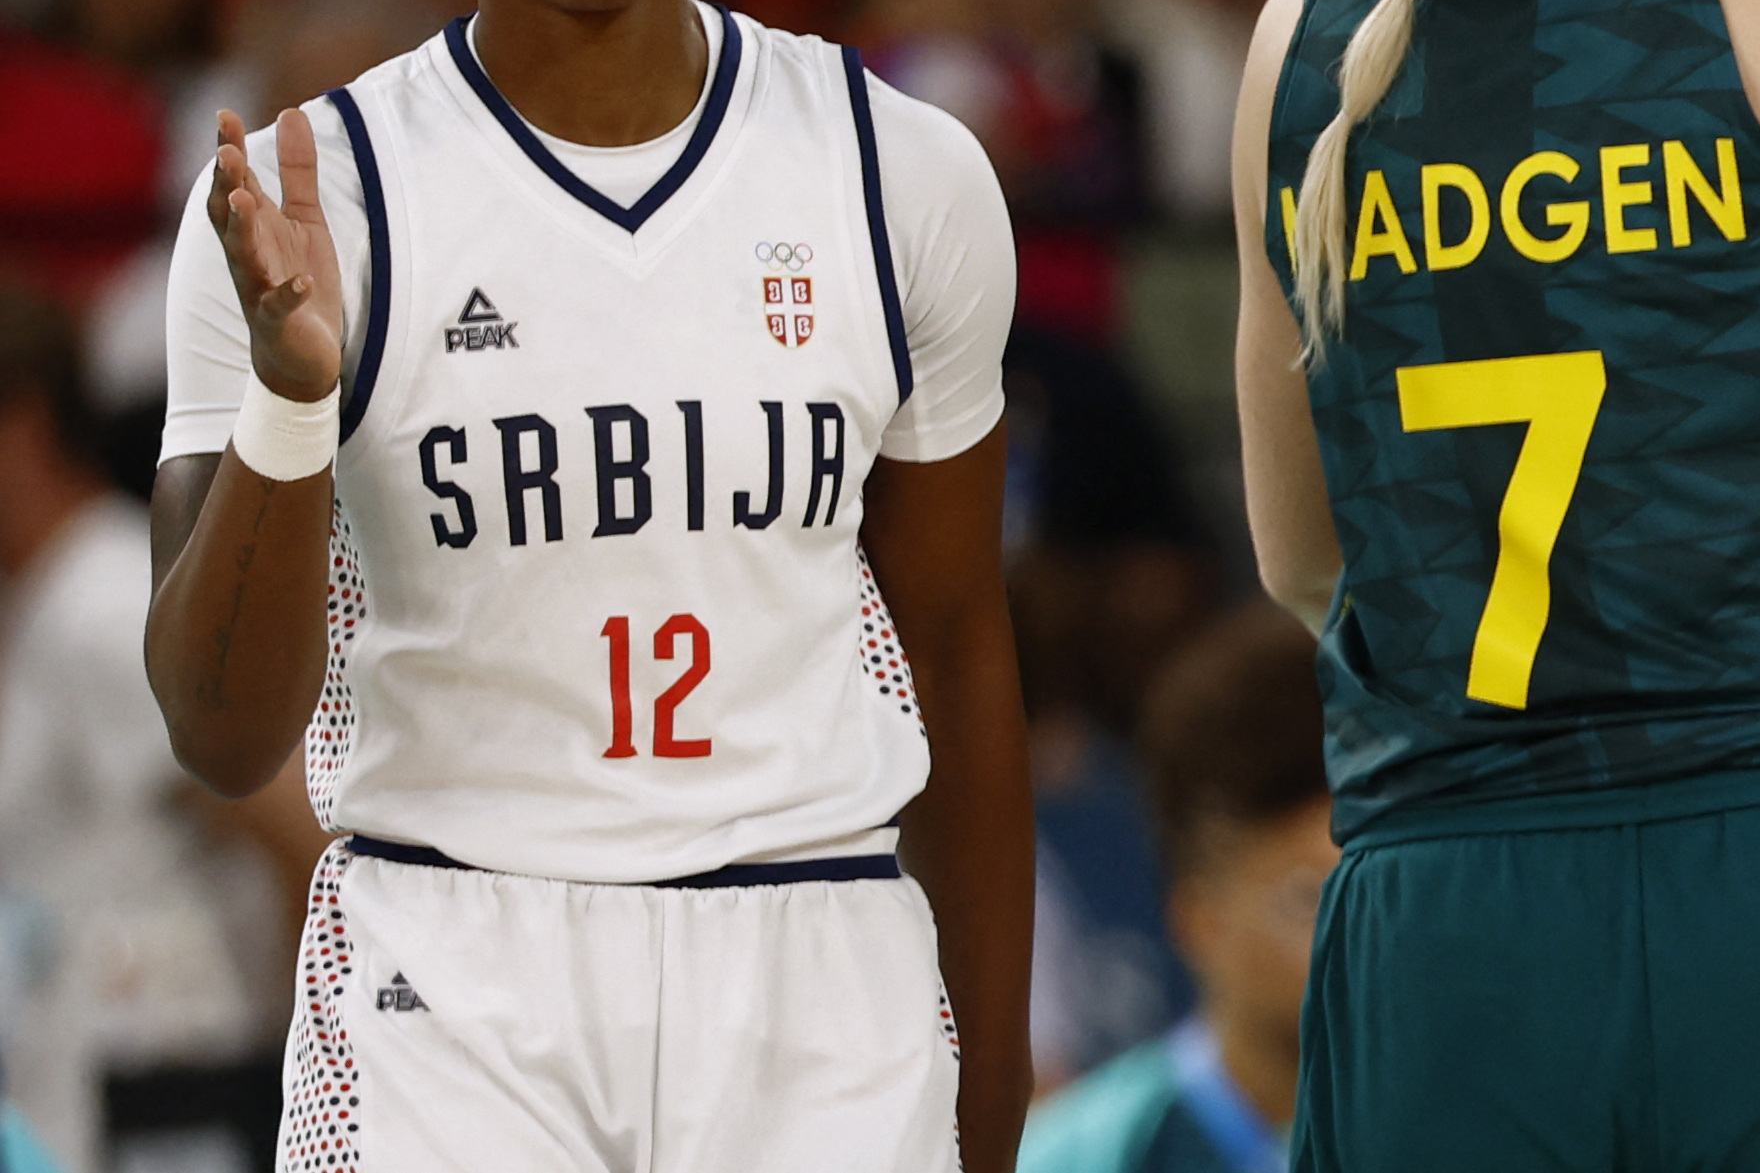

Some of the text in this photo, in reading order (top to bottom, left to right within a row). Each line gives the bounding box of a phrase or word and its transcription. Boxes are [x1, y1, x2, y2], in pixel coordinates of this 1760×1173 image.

[444, 322, 520, 353] PEAK
[418, 399, 846, 549] SRBIJA
[1396, 350, 1606, 710] 7
[600, 613, 712, 758] 12
[376, 987, 431, 1013] PEA
